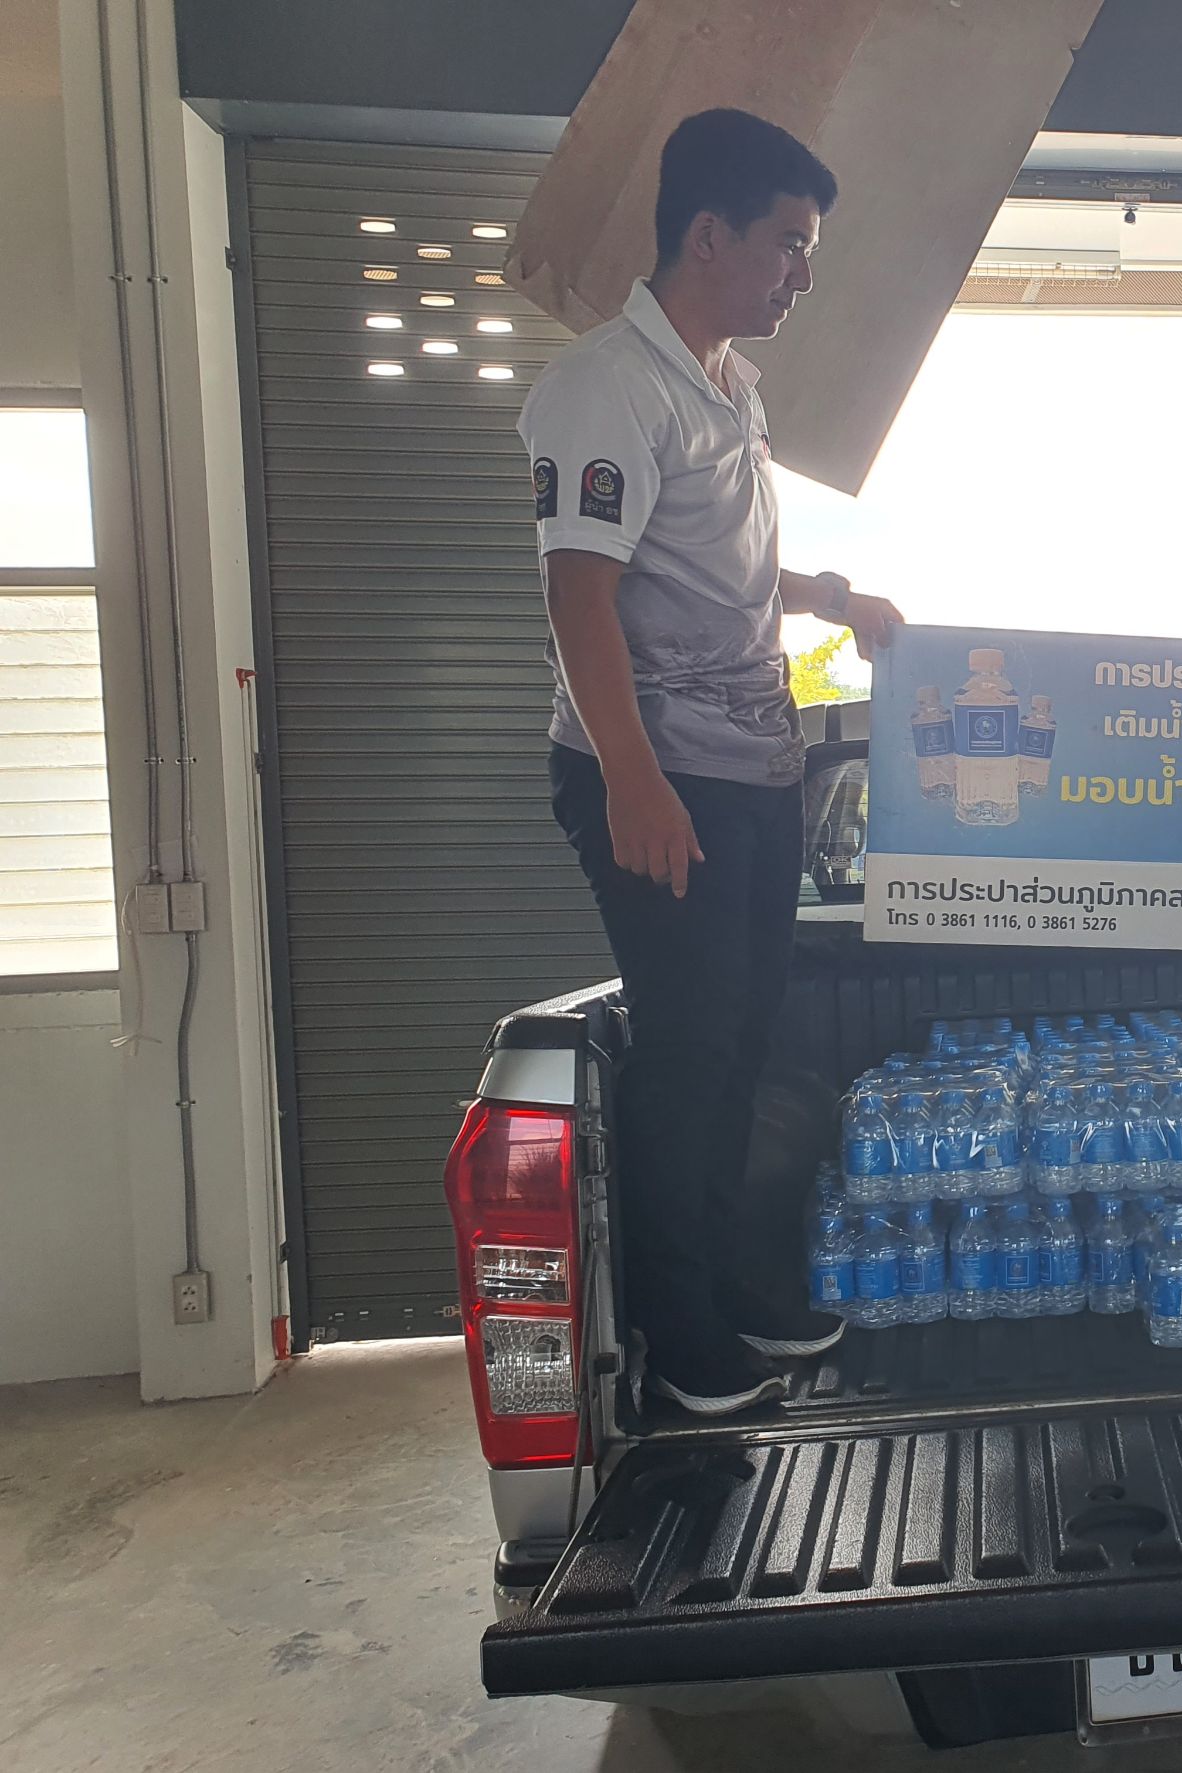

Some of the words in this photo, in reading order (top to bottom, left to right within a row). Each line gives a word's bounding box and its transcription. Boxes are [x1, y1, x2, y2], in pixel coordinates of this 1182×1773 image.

[886, 908, 920, 926] โทร
[926, 912, 936, 926] 0
[941, 912, 976, 928] 3861
[983, 914, 1021, 931] 1116,
[1027, 915, 1037, 929] 0
[1041, 916, 1076, 930] 3861
[1082, 917, 1118, 931] 5276
